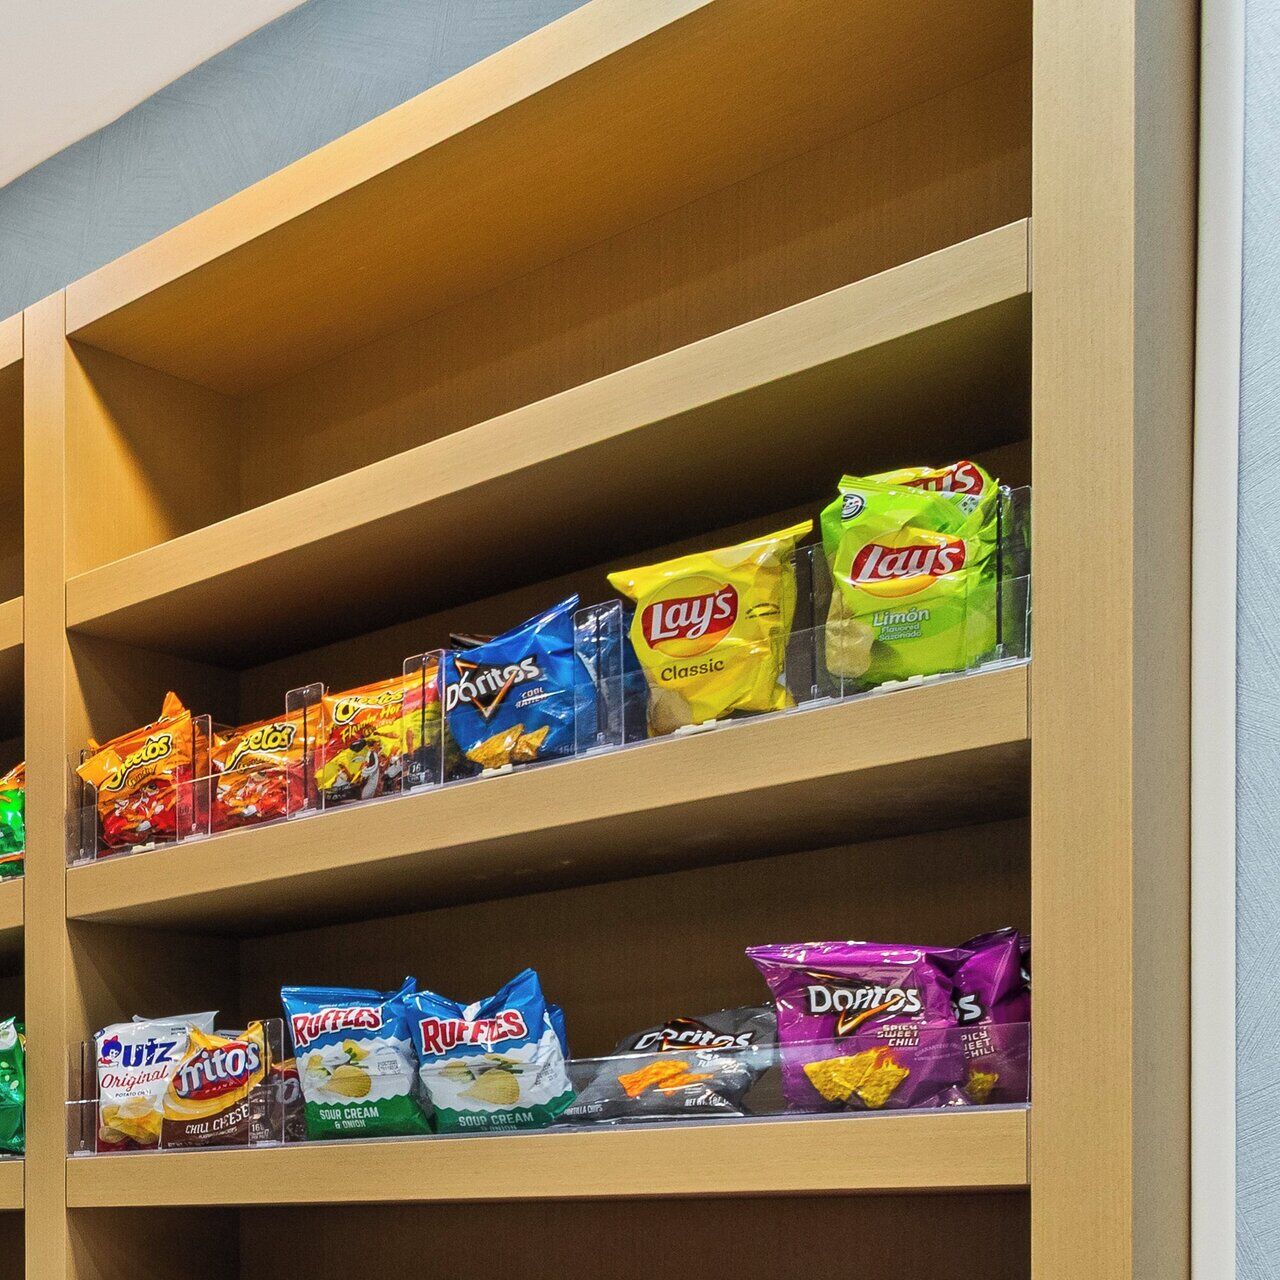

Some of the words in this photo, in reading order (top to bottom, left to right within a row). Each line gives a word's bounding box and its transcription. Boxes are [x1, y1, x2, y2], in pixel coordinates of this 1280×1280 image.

[858, 538, 961, 582] Lay's
[650, 589, 733, 640] Lay's
[873, 607, 930, 627] Limón
[881, 624, 920, 633] Flavored
[661, 658, 725, 681] Classic
[447, 657, 540, 711] Doritos
[808, 986, 922, 1013] Doritos
[293, 1008, 381, 1046] RUFFLES
[961, 1031, 988, 1042] PICY
[888, 1038, 920, 1046] CHILI
[101, 1065, 169, 1092] Original
[177, 1042, 260, 1097] Fritos
[320, 1109, 341, 1120] SOUR
[344, 1107, 379, 1119] CREAM
[491, 1112, 534, 1125] CREAM
[185, 1121, 209, 1134] CHILI
